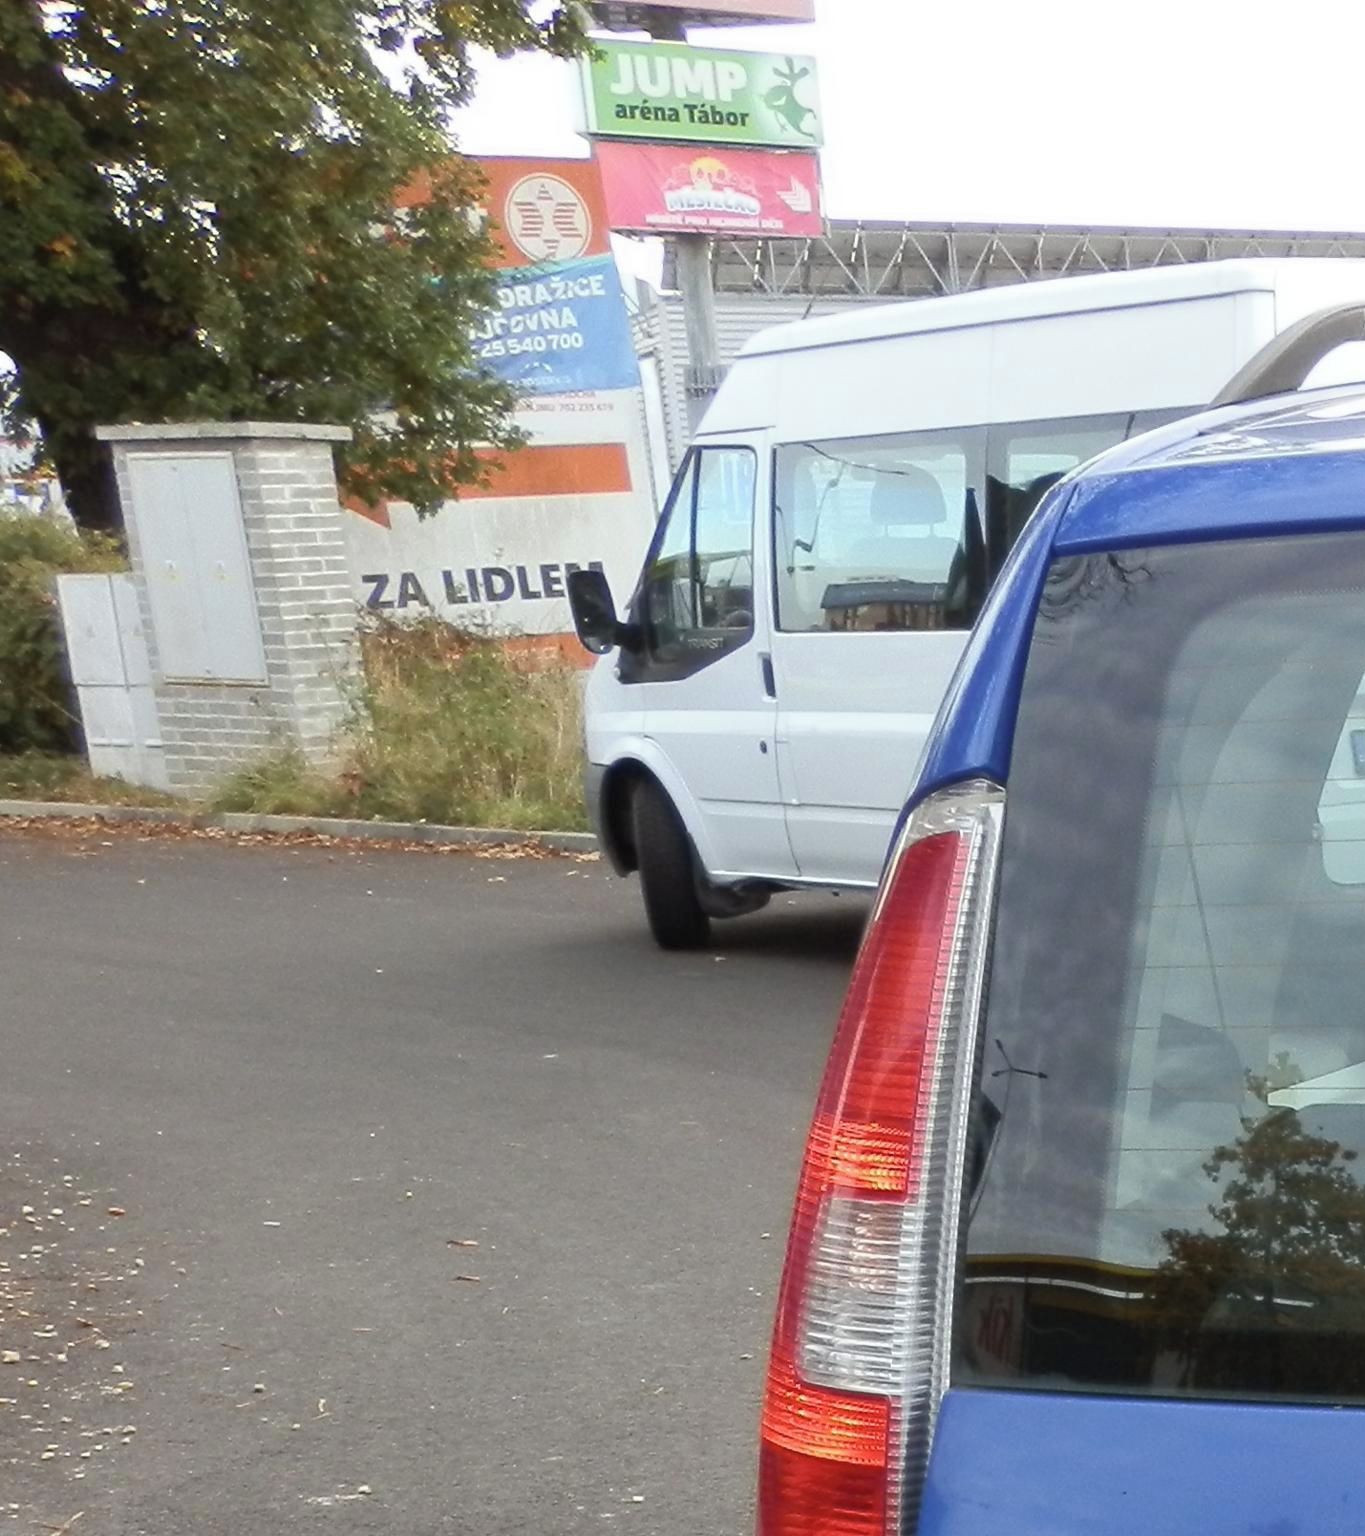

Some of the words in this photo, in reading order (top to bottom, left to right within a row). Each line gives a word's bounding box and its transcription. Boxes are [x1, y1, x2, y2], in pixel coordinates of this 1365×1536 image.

[610, 53, 748, 101] JUMP
[615, 100, 680, 124] aréna
[684, 103, 750, 127] Tábor
[507, 336, 546, 355] 540
[550, 333, 583, 350] 700
[362, 572, 430, 609] ZA
[442, 561, 603, 604] LIDLE
